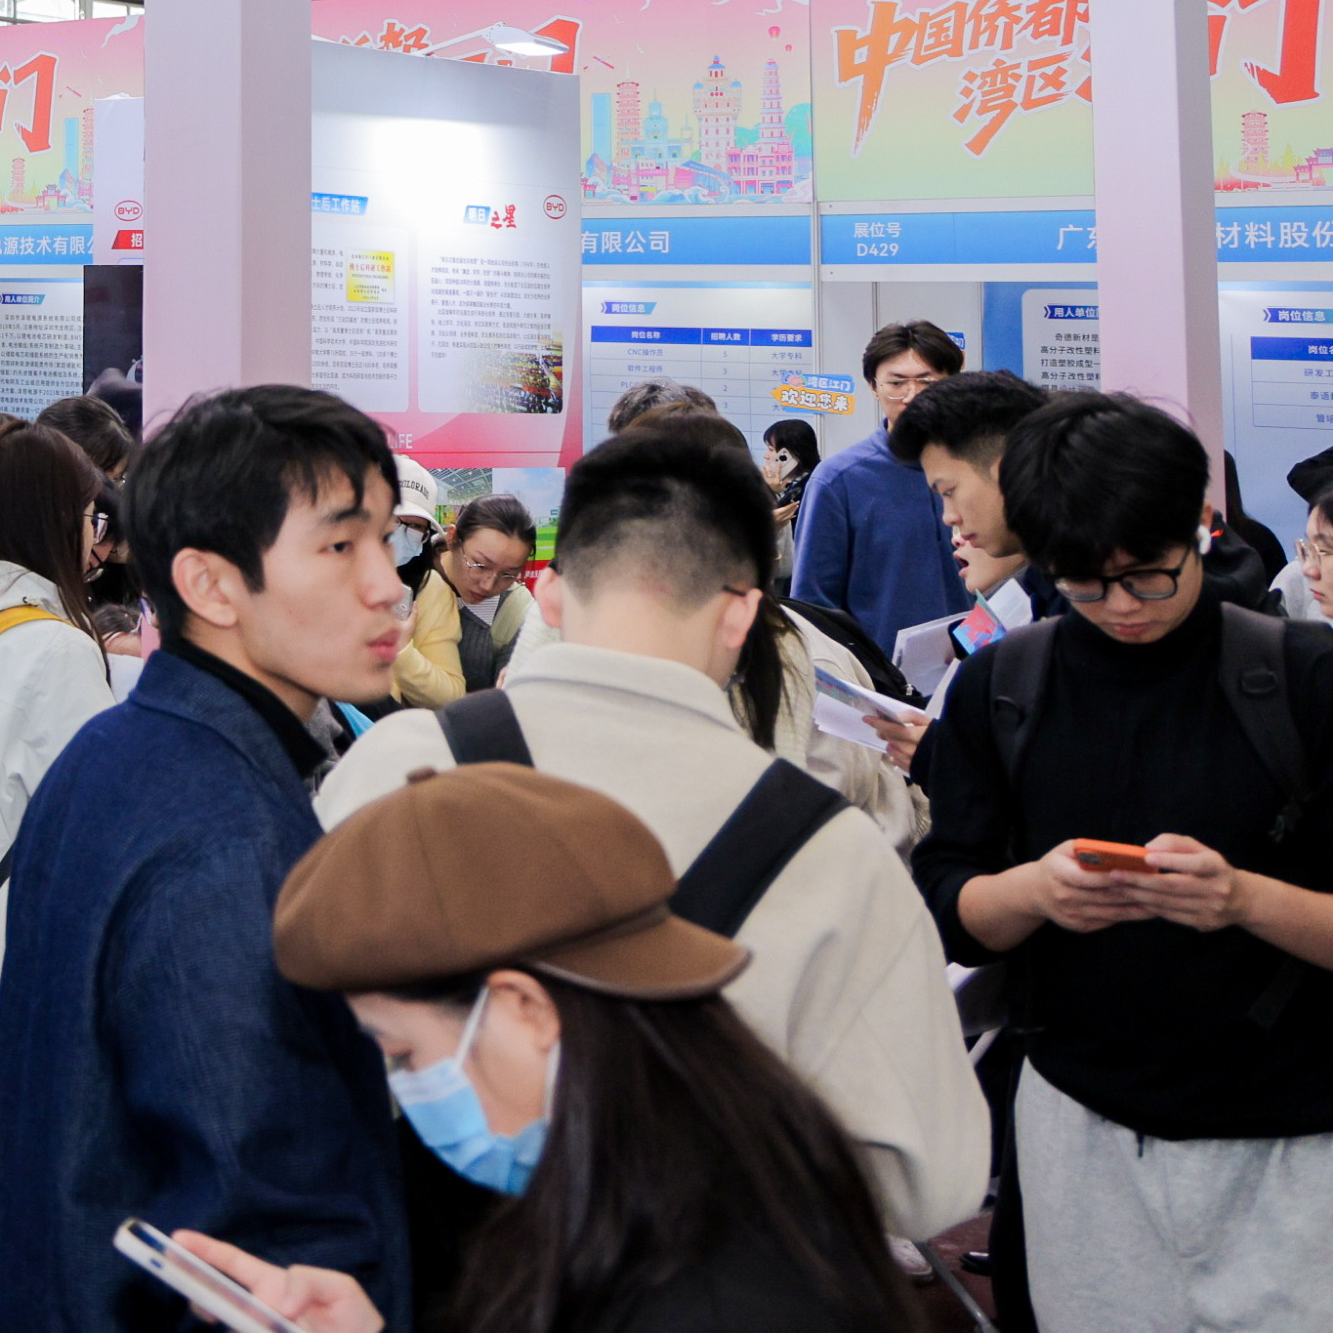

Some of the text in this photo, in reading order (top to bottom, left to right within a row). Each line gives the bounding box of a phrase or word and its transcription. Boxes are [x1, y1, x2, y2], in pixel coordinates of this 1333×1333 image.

[118, 207, 140, 215] BYD
[546, 202, 564, 212] BYD
[854, 220, 901, 239] 展位号
[131, 233, 143, 247] 招
[581, 231, 670, 254] 有限公司
[856, 242, 900, 257] D429
[4, 295, 40, 304] 用人单位简介
[611, 303, 646, 312] 岗位信息
[1054, 307, 1099, 319] 用人单位
[1278, 310, 1326, 322] 岗位信息
[631, 330, 802, 343] 岗位名称 招聘人数 学历要求
[1054, 333, 1099, 343] 奇德新材是
[627, 348, 663, 357] CNC操作员
[771, 351, 802, 360] 大学专科
[627, 364, 663, 373] 软件工程师
[723, 384, 728, 392] 2
[807, 377, 851, 391] 湾区江门
[781, 388, 849, 412] 欢迎您来
